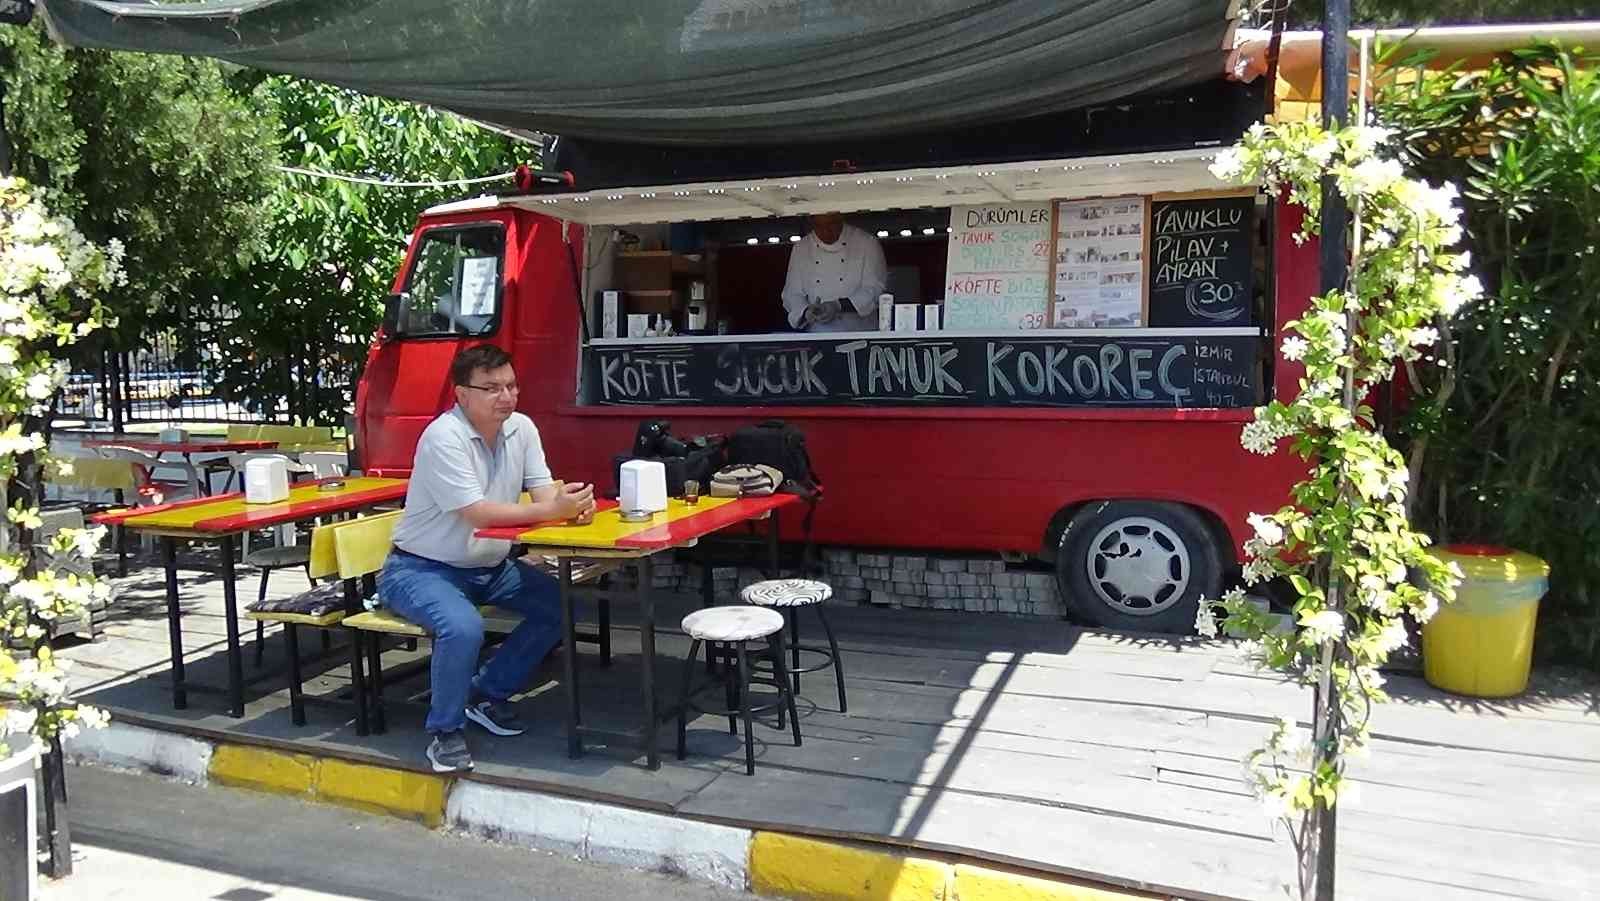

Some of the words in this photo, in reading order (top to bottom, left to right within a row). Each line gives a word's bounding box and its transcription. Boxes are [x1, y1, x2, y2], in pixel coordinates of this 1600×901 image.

[1154, 205, 1243, 233] TAVUKLU
[960, 231, 995, 245] TAVUK
[1155, 257, 1217, 284] AYRAN
[1199, 282, 1234, 304] 30
[600, 352, 691, 400] KÖFTE
[714, 344, 829, 396] SUCUK
[835, 339, 965, 395] TAVUK
[986, 341, 1193, 408] KOKOREÇ
